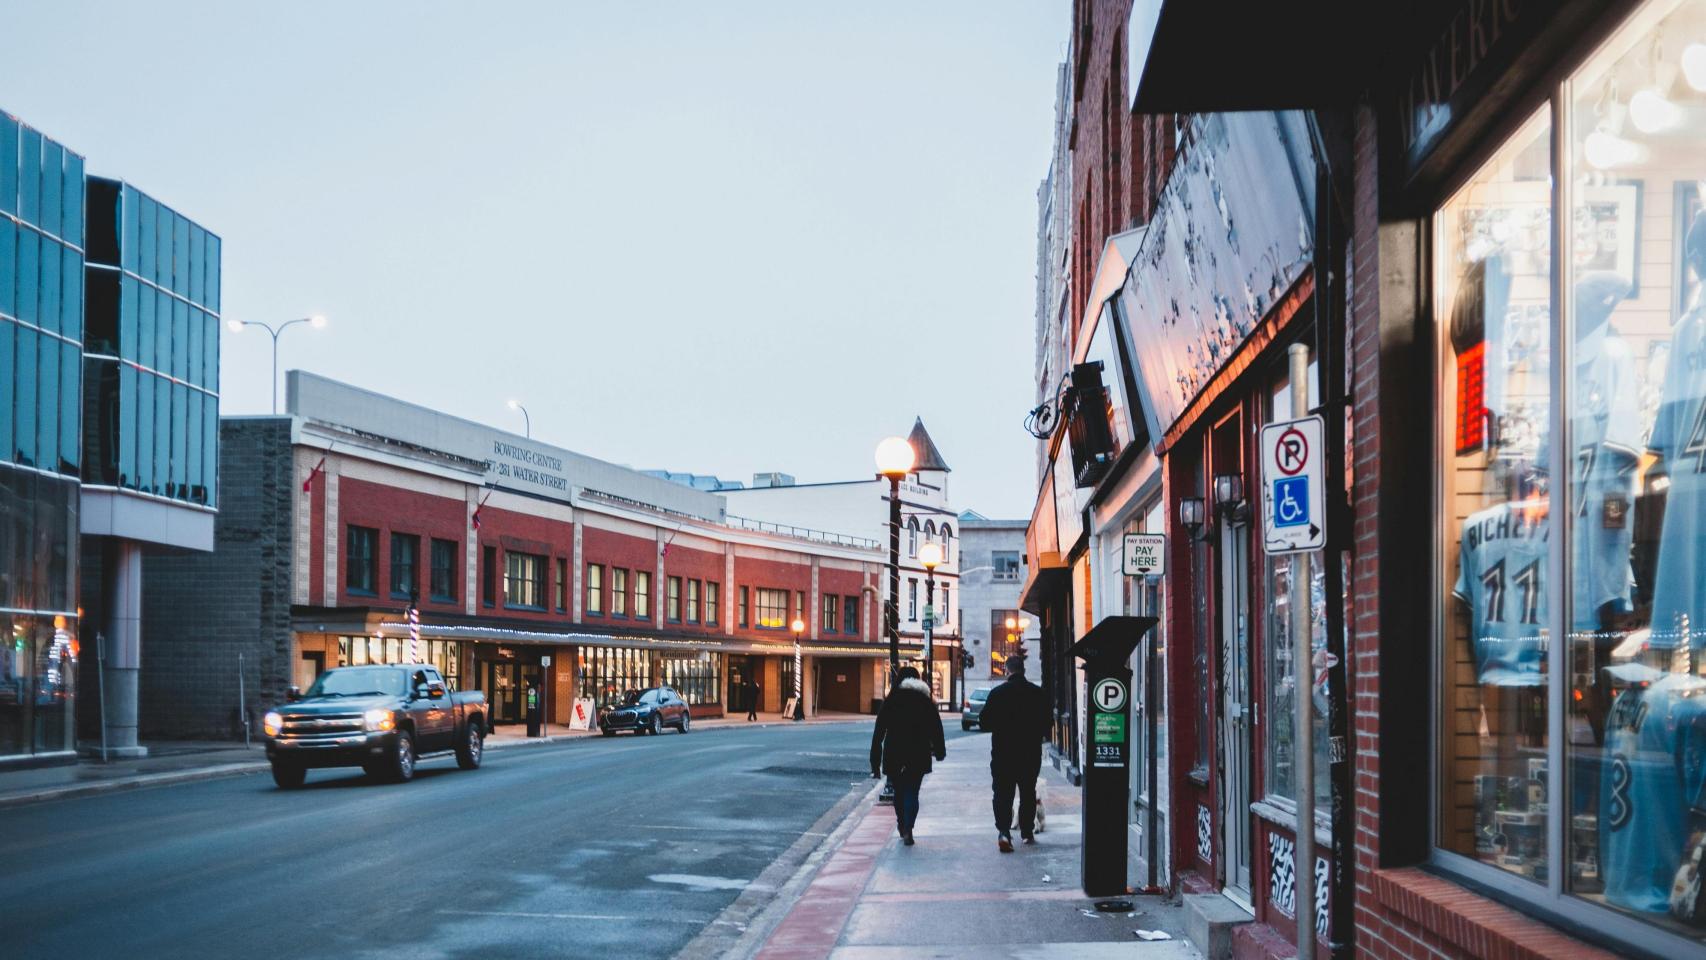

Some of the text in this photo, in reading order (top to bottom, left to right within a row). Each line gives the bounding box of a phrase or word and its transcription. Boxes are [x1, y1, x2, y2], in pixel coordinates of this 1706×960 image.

[1398, 0, 1521, 153] MAVERI
[494, 441, 562, 472] BOWRING CENTRE
[1285, 440, 1301, 466] P
[513, 465, 539, 484] WATER
[539, 473, 568, 491] STREET
[1468, 511, 1550, 551] BICHE
[1131, 556, 1158, 566] HERE
[1135, 546, 1154, 555] PAY
[1479, 557, 1541, 625] 11
[1104, 685, 1119, 706] P
[1096, 746, 1121, 756] 1331
